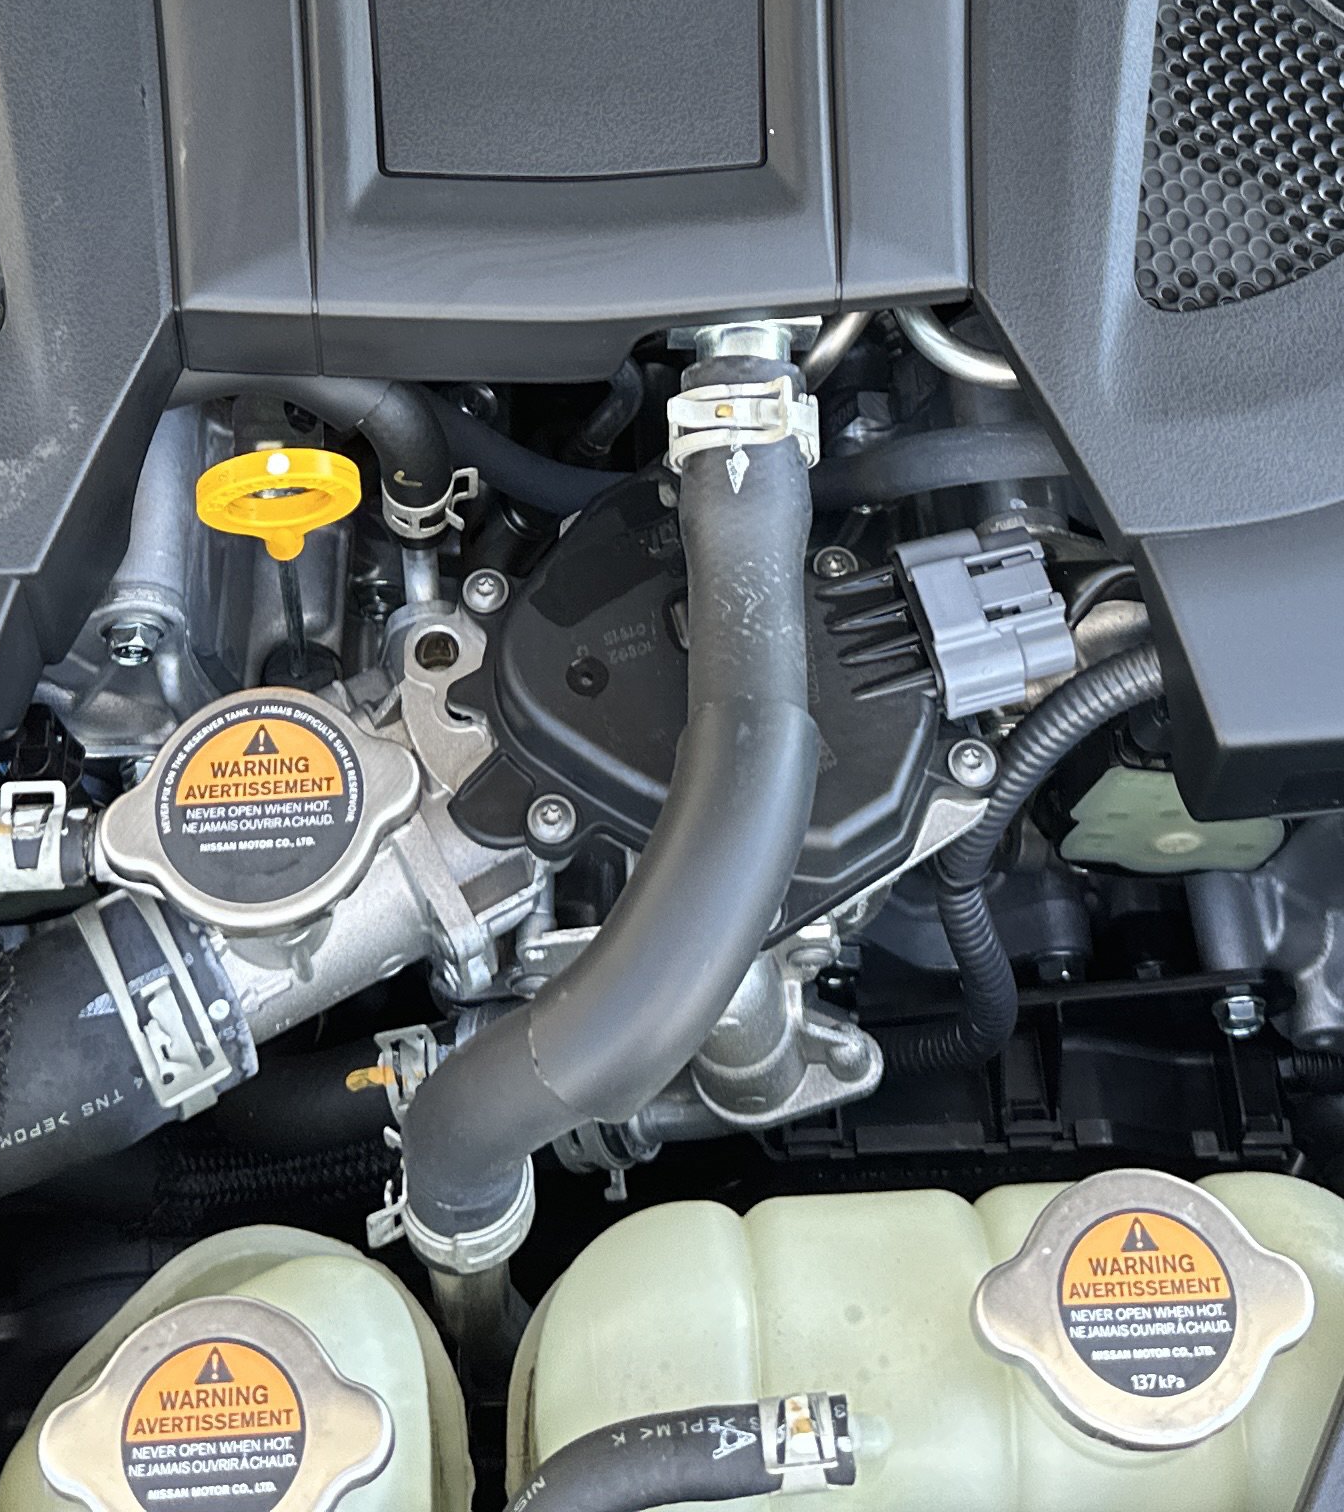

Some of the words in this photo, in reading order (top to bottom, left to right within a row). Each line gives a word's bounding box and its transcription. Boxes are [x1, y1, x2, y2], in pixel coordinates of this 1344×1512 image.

[260, 705, 292, 716] JAMAIS
[333, 739, 349, 757] SUR
[172, 750, 187, 769] THE
[211, 756, 309, 778] WARNING
[343, 756, 355, 770] LE
[165, 768, 177, 785] ON
[185, 776, 334, 800] AVERTISSEMENT
[160, 802, 172, 834] NEVER
[186, 806, 225, 820] NEVER
[228, 804, 261, 818] OPEN
[263, 802, 302, 817] WHEN
[305, 800, 331, 812] HOT.
[182, 822, 197, 834] NE
[198, 819, 238, 833] JAMAIS
[239, 817, 281, 830] OUVRIR
[292, 814, 334, 827] CHAUD.
[200, 841, 236, 853] NISSAN
[238, 840, 274, 851] MOTOR
[296, 837, 315, 846] LTD.
[81, 1088, 125, 1118] TNS
[1088, 1254, 1195, 1276] WARNING
[1069, 1277, 1221, 1299] AVERTISSEMENT
[1071, 1308, 1114, 1323] NEVER
[1116, 1307, 1151, 1321] OPEN
[1154, 1305, 1194, 1320] WHEN
[1196, 1304, 1226, 1317] HOT.
[1070, 1326, 1086, 1338] NE
[1086, 1324, 1129, 1339] JAMAIS
[1130, 1322, 1175, 1336] OUVRIR
[1185, 1320, 1232, 1334] CHAUD.
[1091, 1349, 1131, 1361] NISSAN
[1133, 1348, 1170, 1359] MOTOR
[1194, 1346, 1216, 1356] LTD.
[1130, 1374, 1156, 1389] 137
[1158, 1375, 1185, 1388] kPa
[159, 1385, 268, 1411] WARNING
[133, 1409, 294, 1436] AVERTISSEMENT
[132, 1445, 176, 1460] NEVER
[179, 1442, 216, 1457] OPEN
[219, 1439, 260, 1455] WHEN
[264, 1437, 293, 1451] HOT.
[128, 1464, 146, 1477] NE
[145, 1461, 191, 1477] JAMAIS
[192, 1458, 238, 1474] OUVRIR
[249, 1454, 298, 1469] CHAUD.
[147, 1487, 189, 1501] NISSAN
[192, 1484, 230, 1498] MOTOR
[254, 1481, 277, 1493] LTD.
